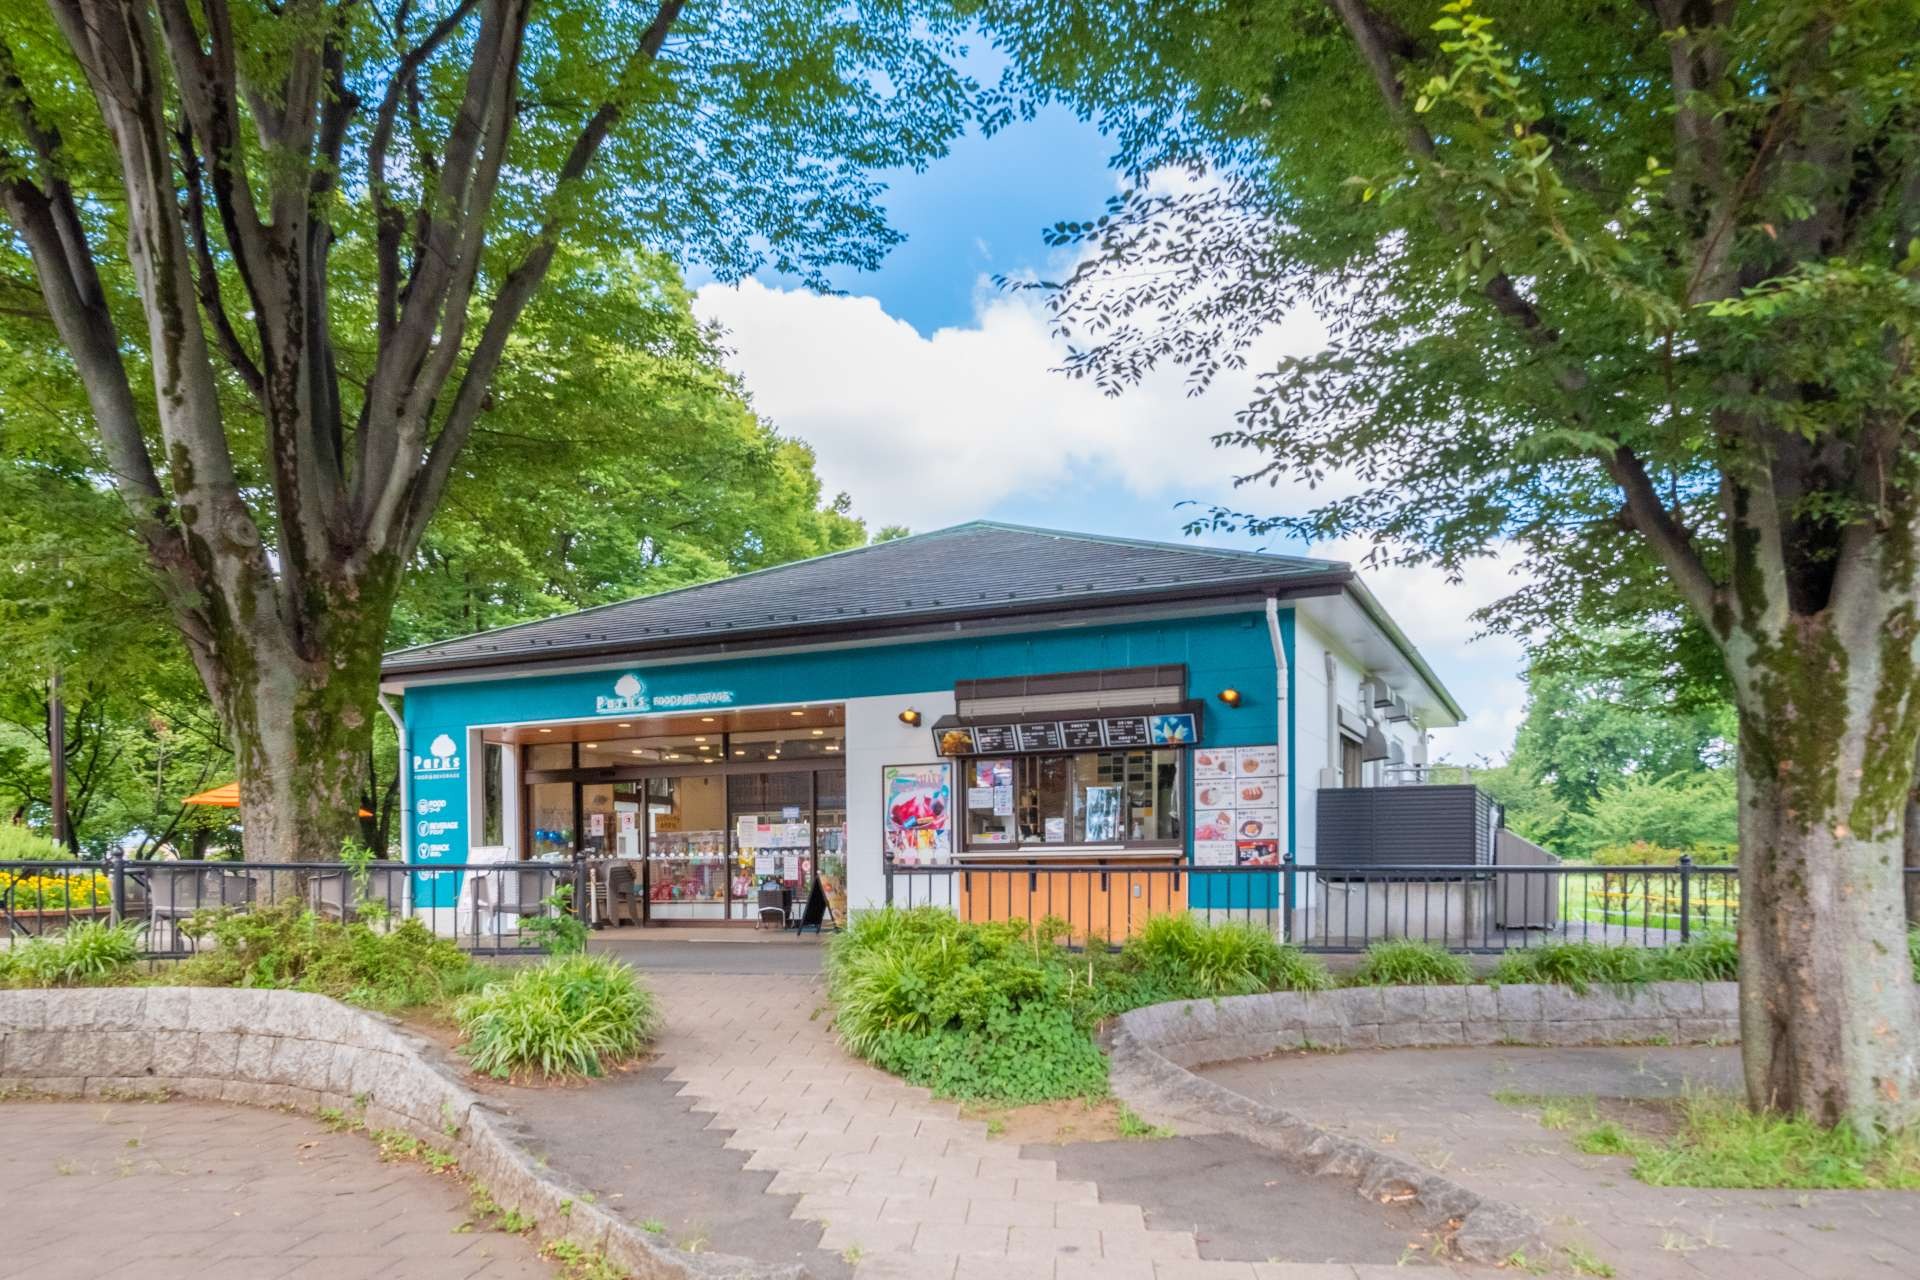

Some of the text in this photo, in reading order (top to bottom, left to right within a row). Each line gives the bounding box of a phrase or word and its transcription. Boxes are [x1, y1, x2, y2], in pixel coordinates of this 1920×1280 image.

[596, 696, 646, 709] Parks
[413, 755, 460, 769] Parks
[428, 799, 447, 807] FOOD
